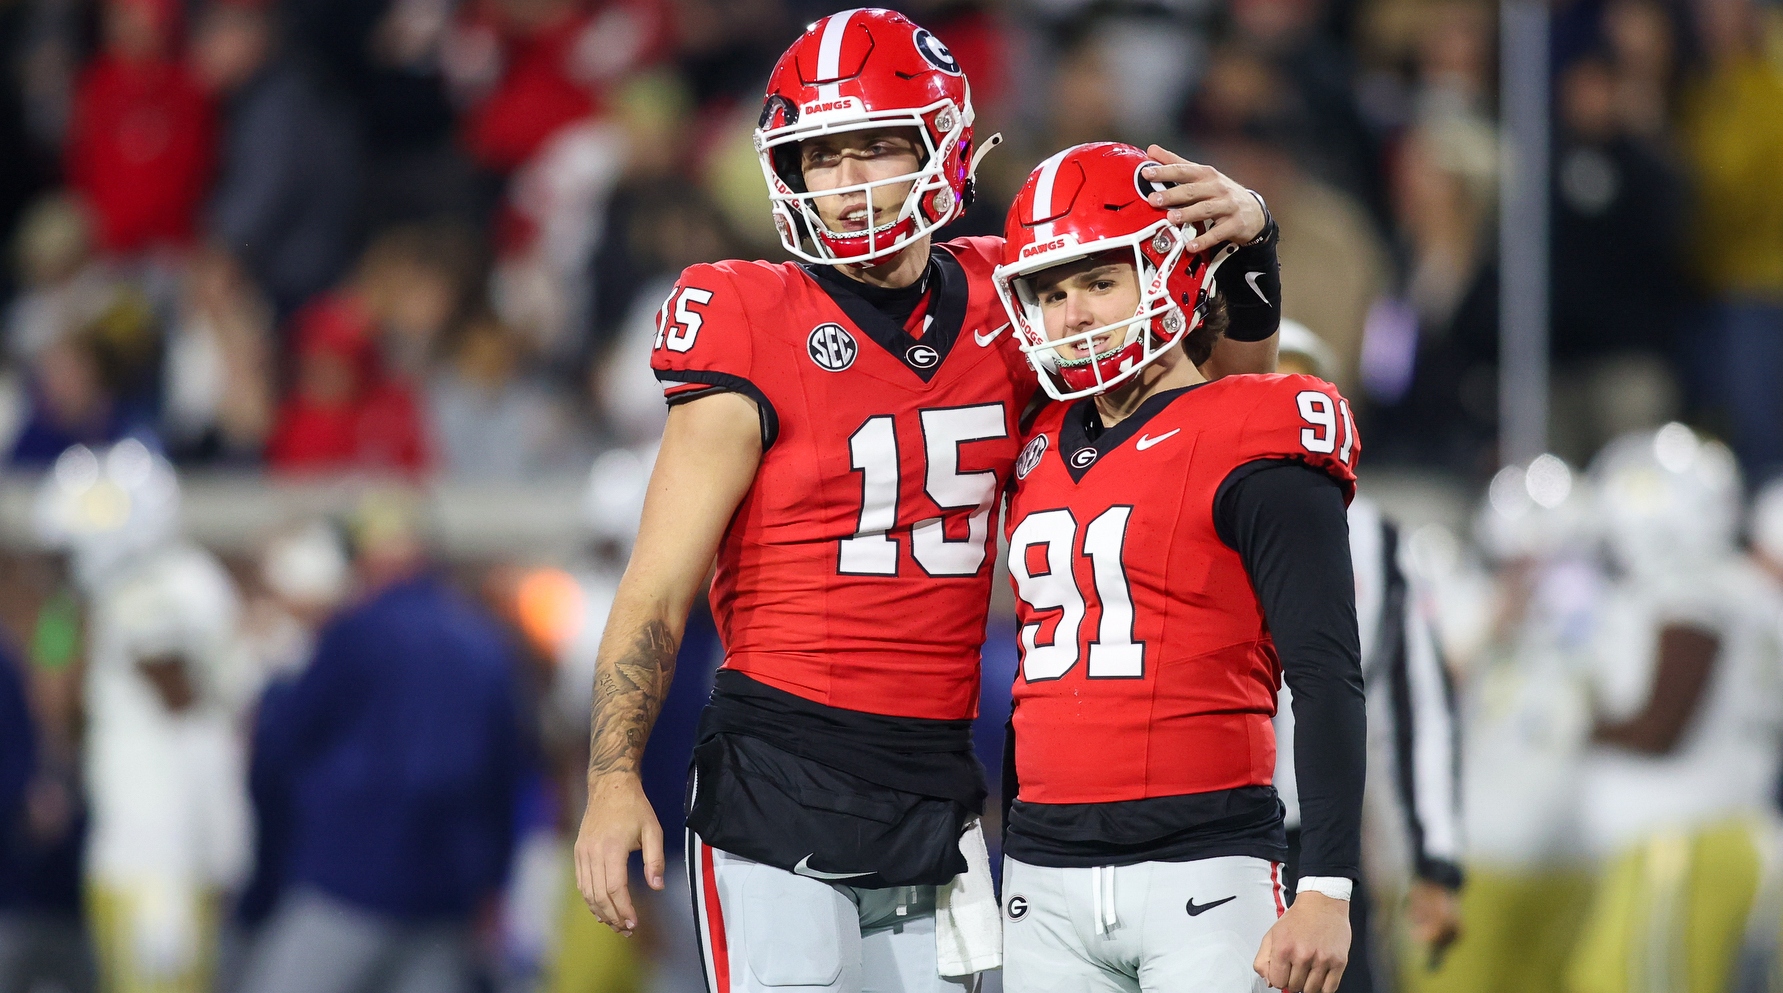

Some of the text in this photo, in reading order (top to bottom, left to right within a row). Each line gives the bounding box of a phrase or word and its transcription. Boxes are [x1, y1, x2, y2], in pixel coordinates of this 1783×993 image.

[805, 100, 852, 115] DAWGS
[1023, 239, 1065, 258] DAWGS
[654, 286, 714, 353] 15
[1020, 318, 1044, 346] DOGS
[811, 326, 854, 369] SEC
[906, 345, 938, 368] G
[1295, 389, 1353, 467] 91
[1071, 447, 1097, 469] G
[836, 401, 1009, 578] 15
[1007, 504, 1146, 684] 91
[1007, 896, 1028, 919] G
